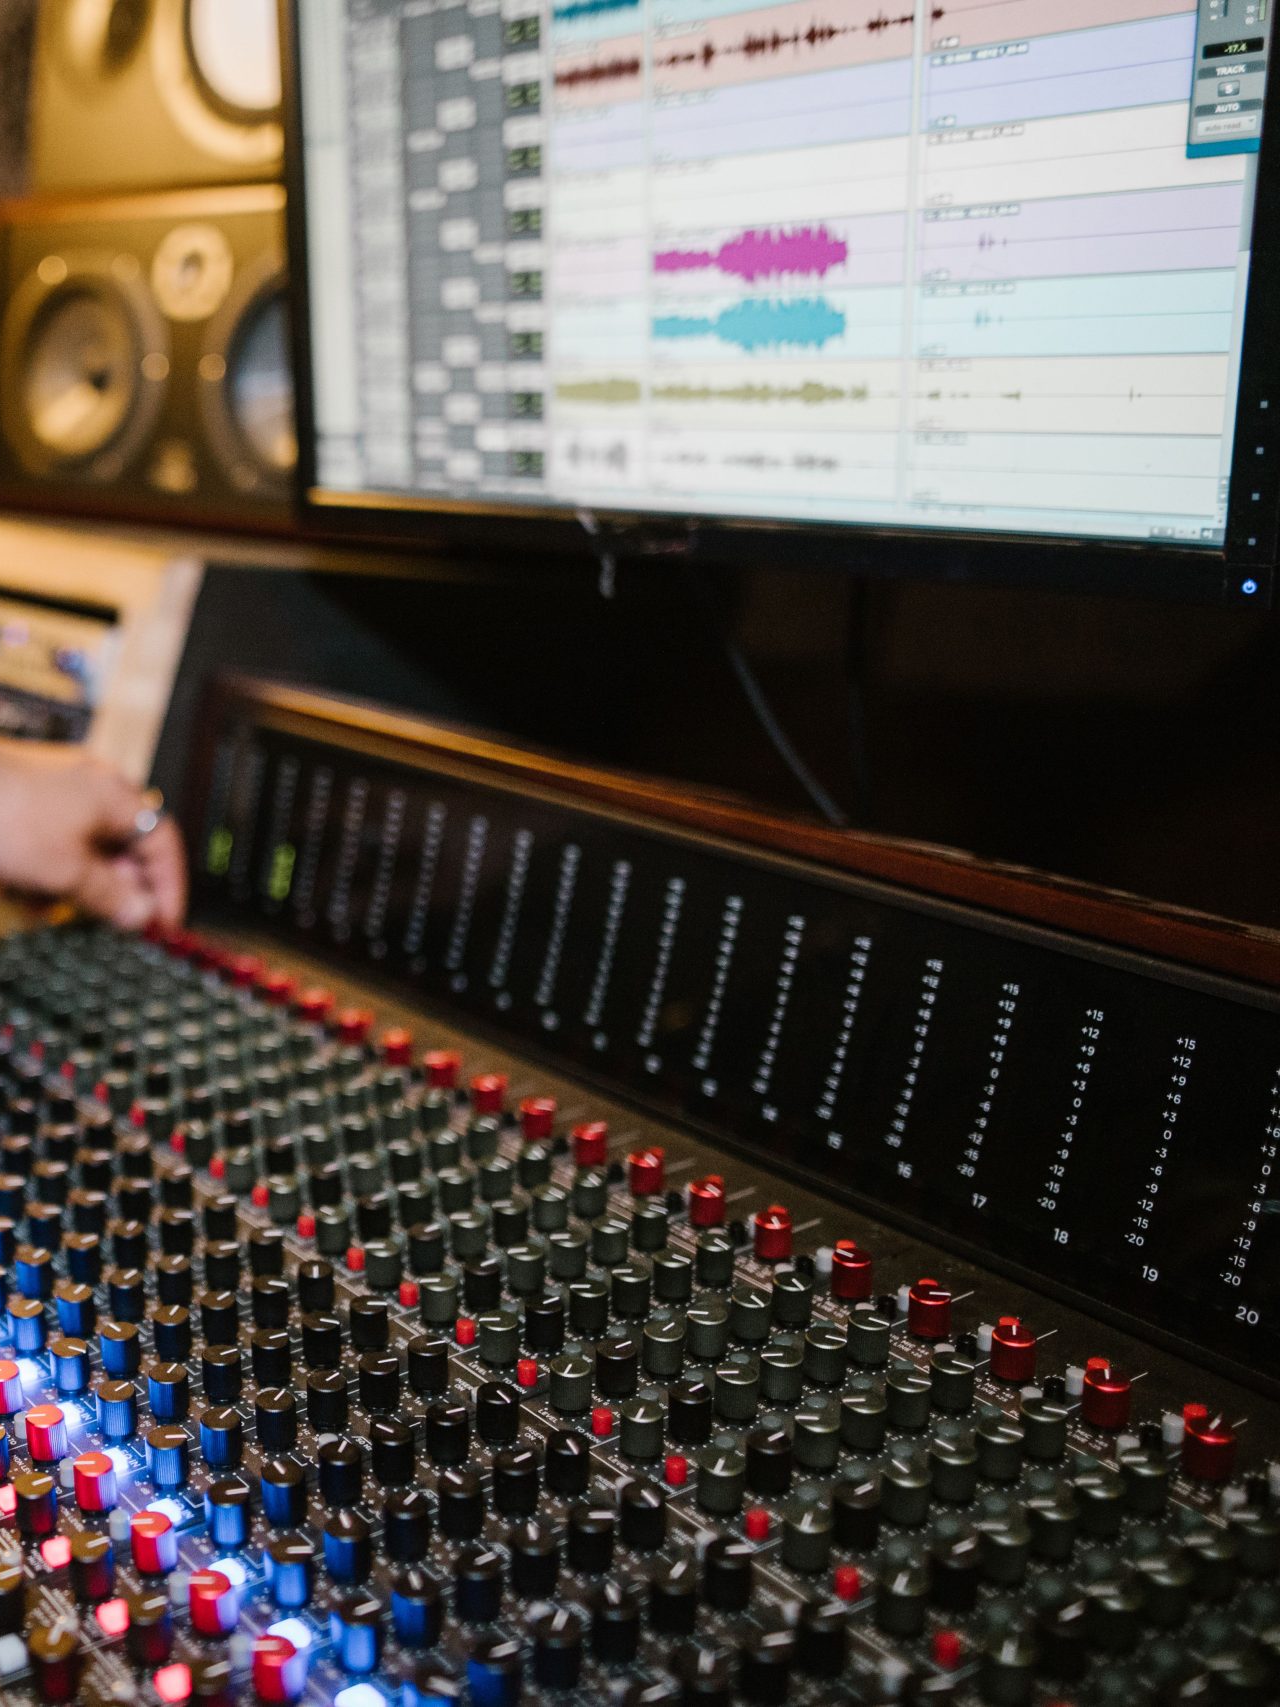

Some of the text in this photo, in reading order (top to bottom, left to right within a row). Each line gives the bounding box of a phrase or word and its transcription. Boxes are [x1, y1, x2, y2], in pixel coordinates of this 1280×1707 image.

[1216, 64, 1246, 77] TRACK
[1224, 84, 1233, 95] S
[1214, 103, 1239, 114] AUTO
[1205, 123, 1221, 132] auto
[1002, 983, 1020, 996] +15
[998, 999, 1016, 1013] +12
[1085, 1009, 1104, 1022] +15
[997, 1017, 1012, 1030] +9
[1081, 1026, 1100, 1040] +12
[993, 1034, 1007, 1046] +6
[1176, 1037, 1196, 1051] +15
[1080, 1045, 1096, 1057] +9
[1076, 1062, 1091, 1074] +6
[1171, 1055, 1192, 1069] +12
[990, 1067, 999, 1079] 0
[1072, 1079, 1087, 1092] +3
[1171, 1074, 1187, 1087] +9
[1073, 1097, 1082, 1108] 0
[1166, 1092, 1182, 1105] +6
[1066, 1114, 1078, 1126] -3
[1162, 1111, 1177, 1123] +3
[1061, 1132, 1073, 1143] -6
[1163, 1129, 1172, 1141] 0
[1264, 1125, 1280, 1139] +6
[1057, 1148, 1069, 1160] -9
[1155, 1147, 1168, 1159] -3
[1260, 1144, 1277, 1157] +3
[898, 1161, 913, 1179] 16
[957, 1163, 975, 1178] -20
[1049, 1164, 1065, 1177] -12
[1150, 1165, 1163, 1176] -6
[1261, 1164, 1271, 1176] 0
[1045, 1181, 1060, 1194] -15
[1145, 1183, 1159, 1194] -9
[1253, 1183, 1267, 1195] -3
[972, 1192, 988, 1209] 17
[1037, 1196, 1056, 1210] -20
[1137, 1199, 1154, 1212] -12
[1247, 1202, 1262, 1213] -6
[1132, 1216, 1149, 1229] -15
[1242, 1220, 1257, 1231] -9
[1054, 1227, 1069, 1245] 18
[1124, 1232, 1145, 1247] -20
[1233, 1236, 1251, 1250] -12
[1228, 1255, 1246, 1268] -15
[1142, 1265, 1159, 1282] 19
[1219, 1272, 1241, 1286] -20
[1235, 1305, 1259, 1325] 20
[468, 1361, 487, 1376] LEVEL
[455, 1377, 475, 1391] INSER
[503, 1377, 528, 1395] TO MON
[984, 1382, 1000, 1392] MIC
[980, 1386, 996, 1396] LINE
[538, 1408, 558, 1424] LEVEL
[524, 1425, 545, 1441] INSER
[524, 1432, 537, 1441] ON
[575, 1425, 600, 1444] TO MON
[12, 1454, 24, 1467] MON
[130, 1458, 141, 1469] IN
[607, 1455, 629, 1472] LEVEL
